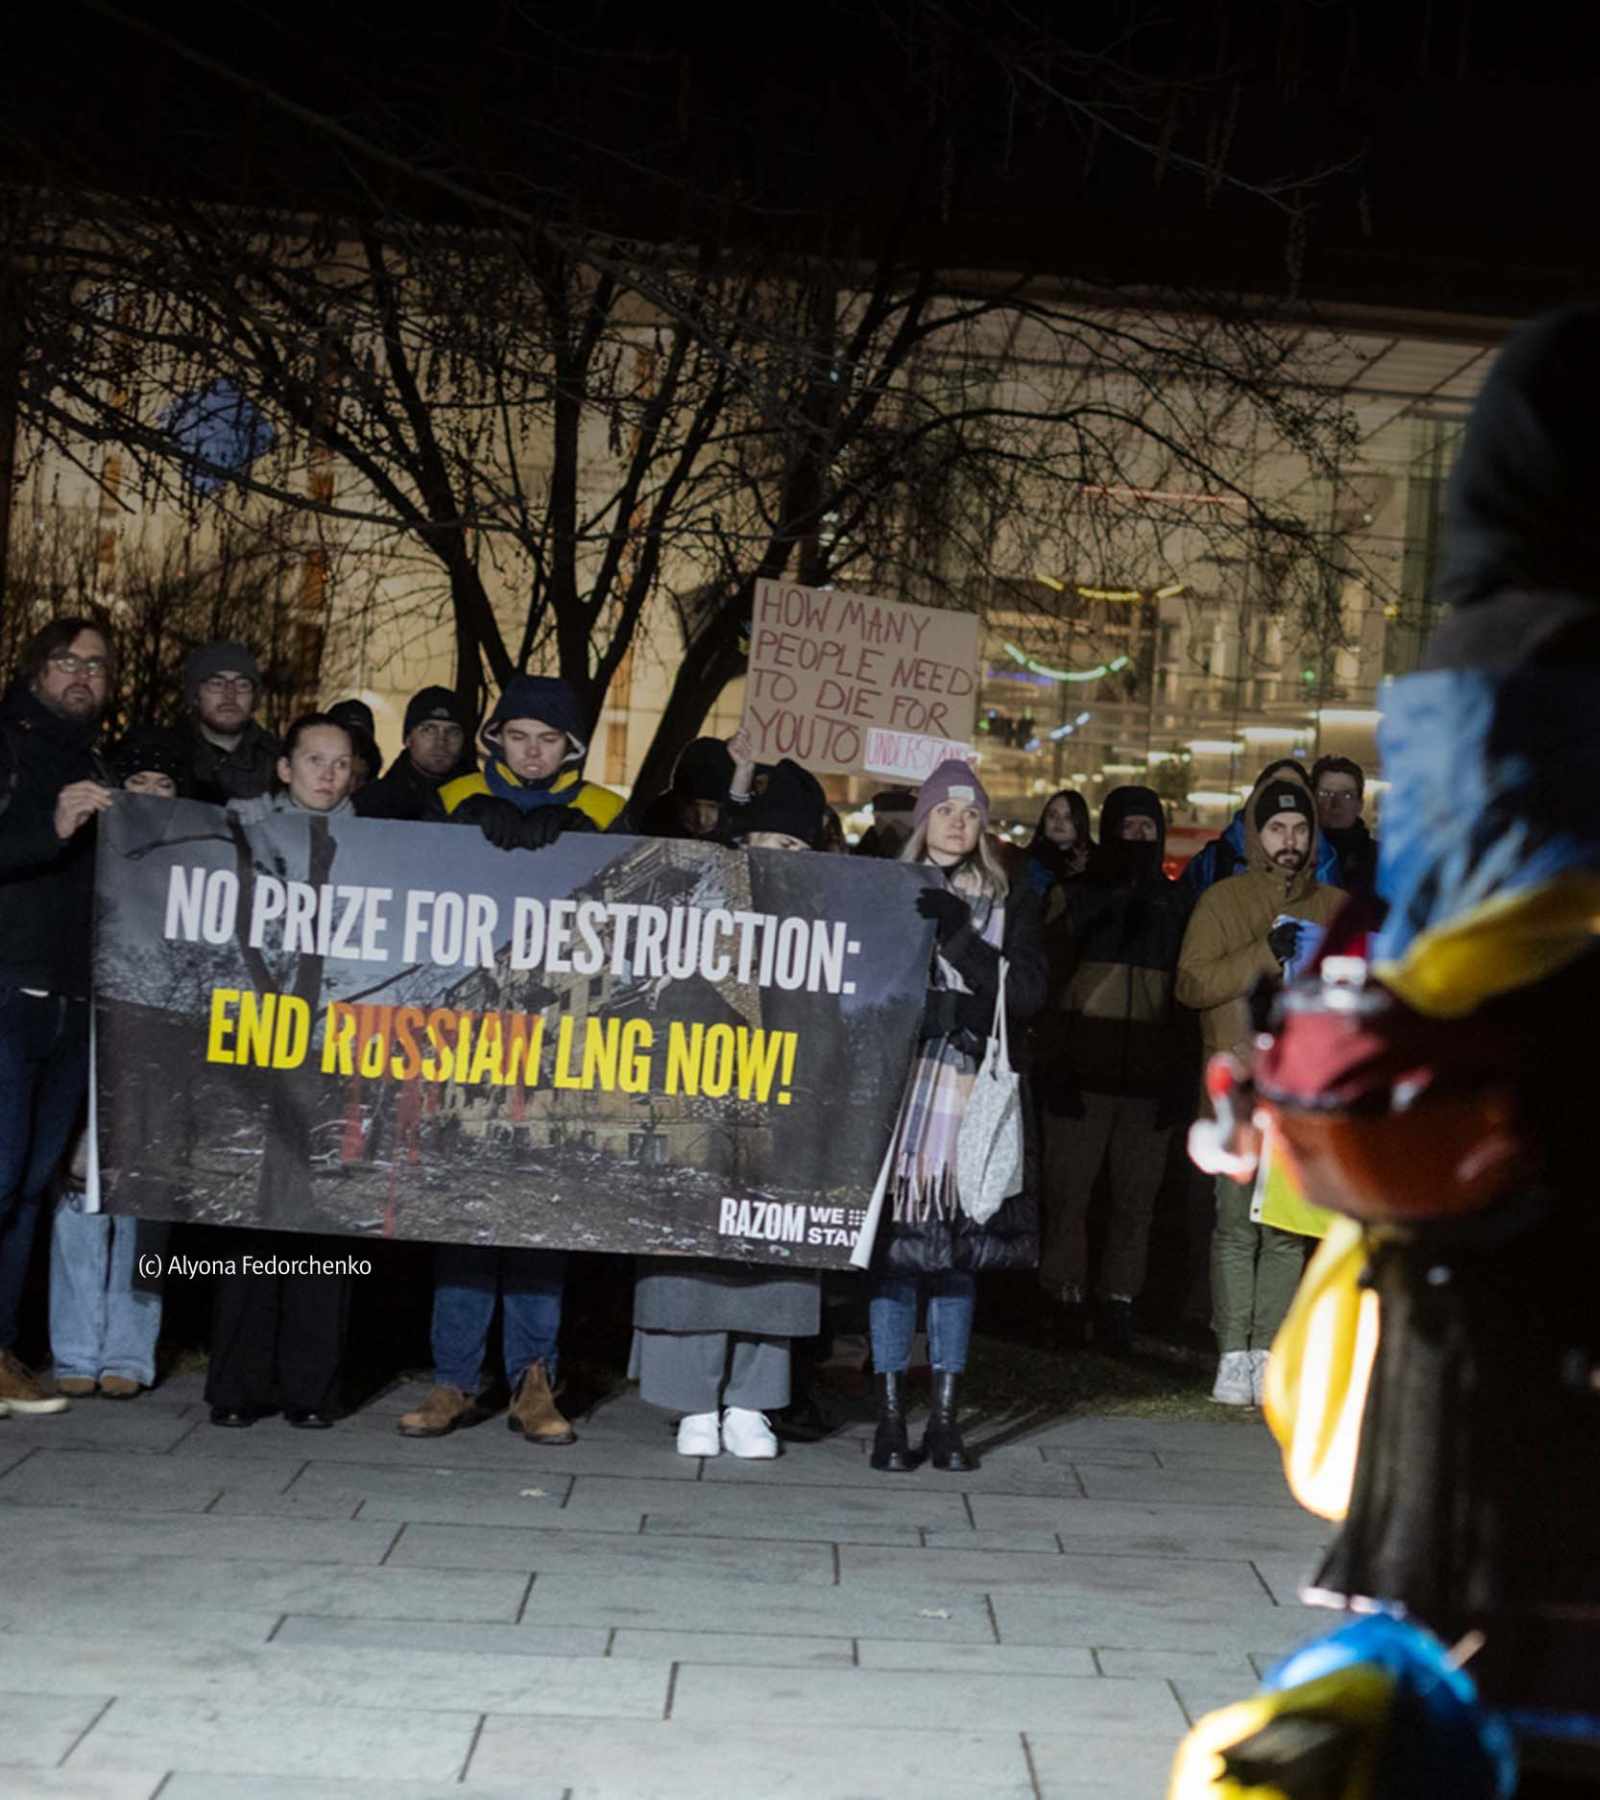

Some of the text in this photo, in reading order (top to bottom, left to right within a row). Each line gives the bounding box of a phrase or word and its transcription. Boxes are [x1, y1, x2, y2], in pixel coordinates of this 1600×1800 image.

[760, 585, 931, 651] HOW MANY
[755, 629, 974, 696] PEOPLE NEED
[752, 668, 951, 738] TO DIE FOR
[164, 865, 861, 995] NO PRIZE FOR DESTRUCTION:
[207, 988, 798, 1105] END RUSSIAN LNG NOW!
[718, 1197, 844, 1244] RAZOM WE
